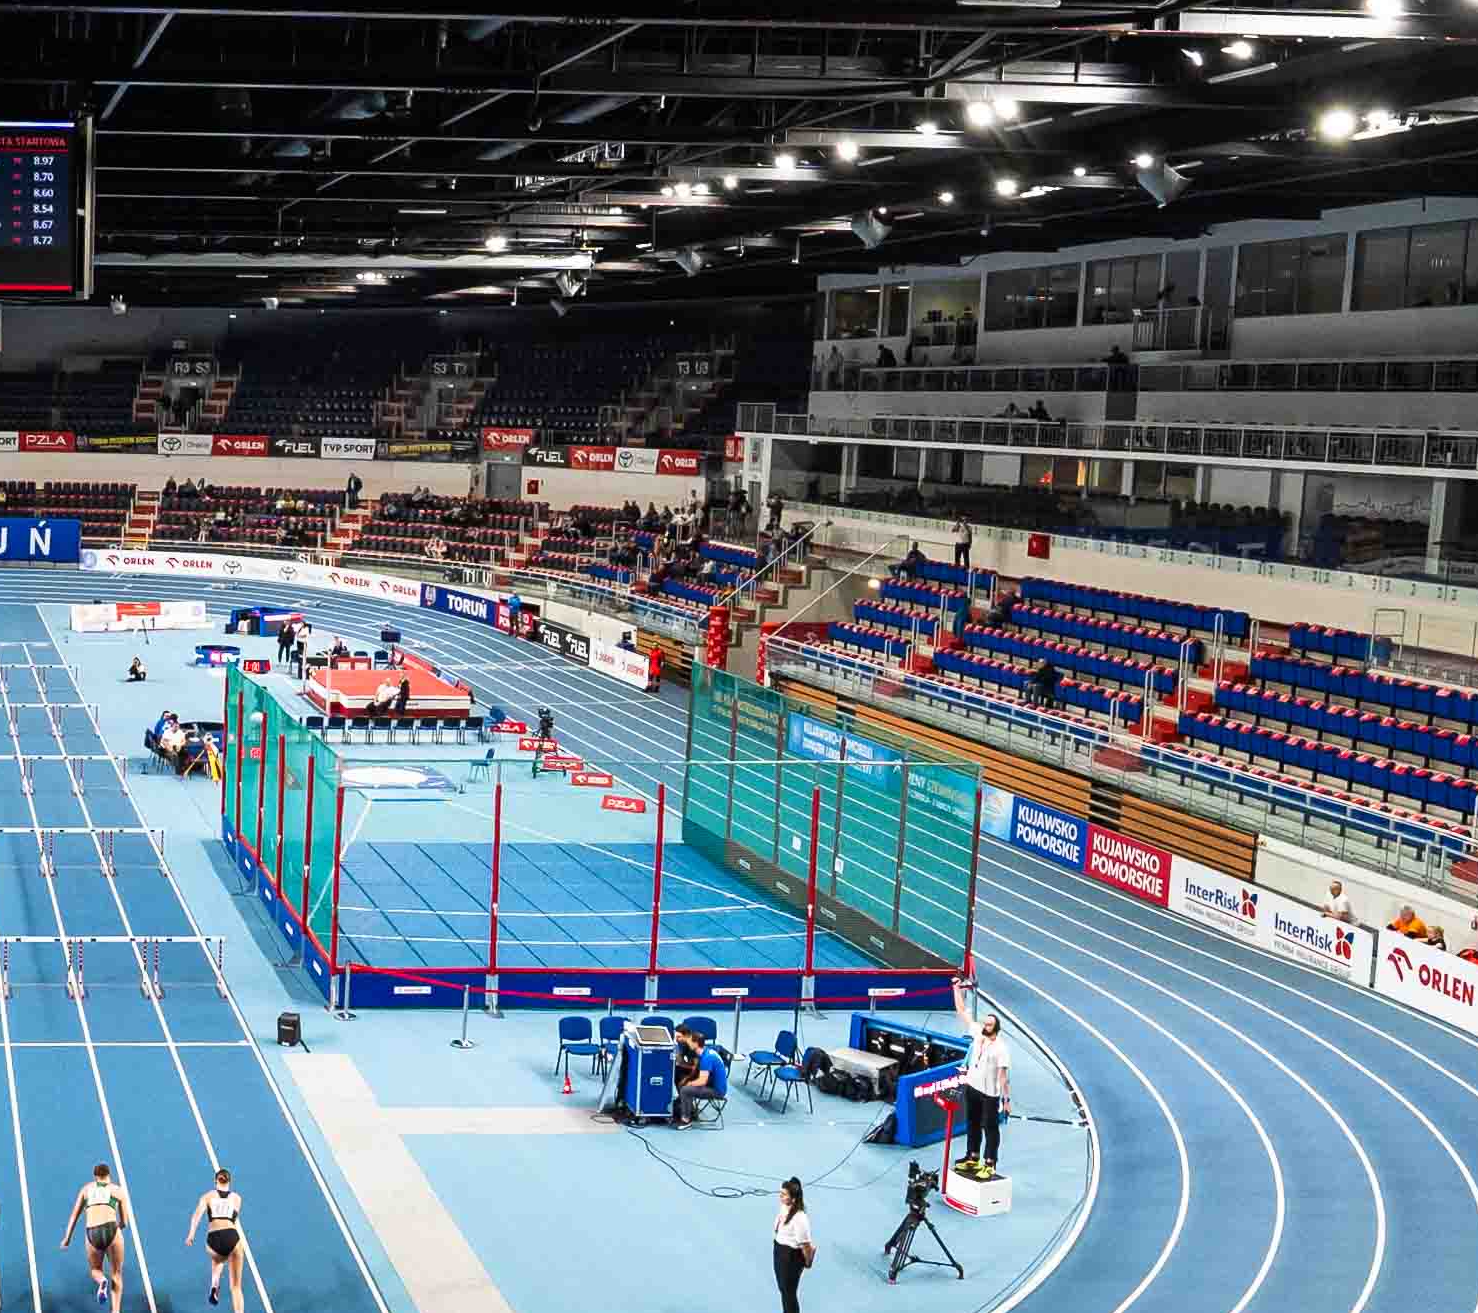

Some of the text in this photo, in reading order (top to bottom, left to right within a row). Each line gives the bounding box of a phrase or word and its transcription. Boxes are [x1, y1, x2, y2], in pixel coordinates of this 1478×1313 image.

[25, 435, 67, 446] PZLA
[501, 432, 530, 444] ORLEN
[284, 442, 316, 454] FUEL
[323, 442, 342, 454] TVP
[345, 442, 374, 454] SPORT
[536, 450, 565, 463] FUEL
[589, 452, 614, 463] ORLEN
[674, 457, 698, 468] ORLEN
[123, 556, 155, 567] ORLEN
[182, 558, 213, 570] ORLEN
[342, 574, 371, 588] ORLEN
[392, 583, 419, 597] ORLEN
[446, 592, 488, 619] TORUŃ
[544, 630, 562, 649] FUEL
[569, 638, 589, 658] FUEL
[1018, 804, 1078, 842] KUJAWSKO
[1016, 822, 1081, 864] POMORSKIE
[1092, 832, 1161, 874] KUJAWSKO
[1091, 851, 1164, 898] POMORSKIE
[1184, 877, 1241, 914] InterRisk
[1274, 912, 1333, 953] InterRisk
[1418, 963, 1475, 1007] ORLEN
